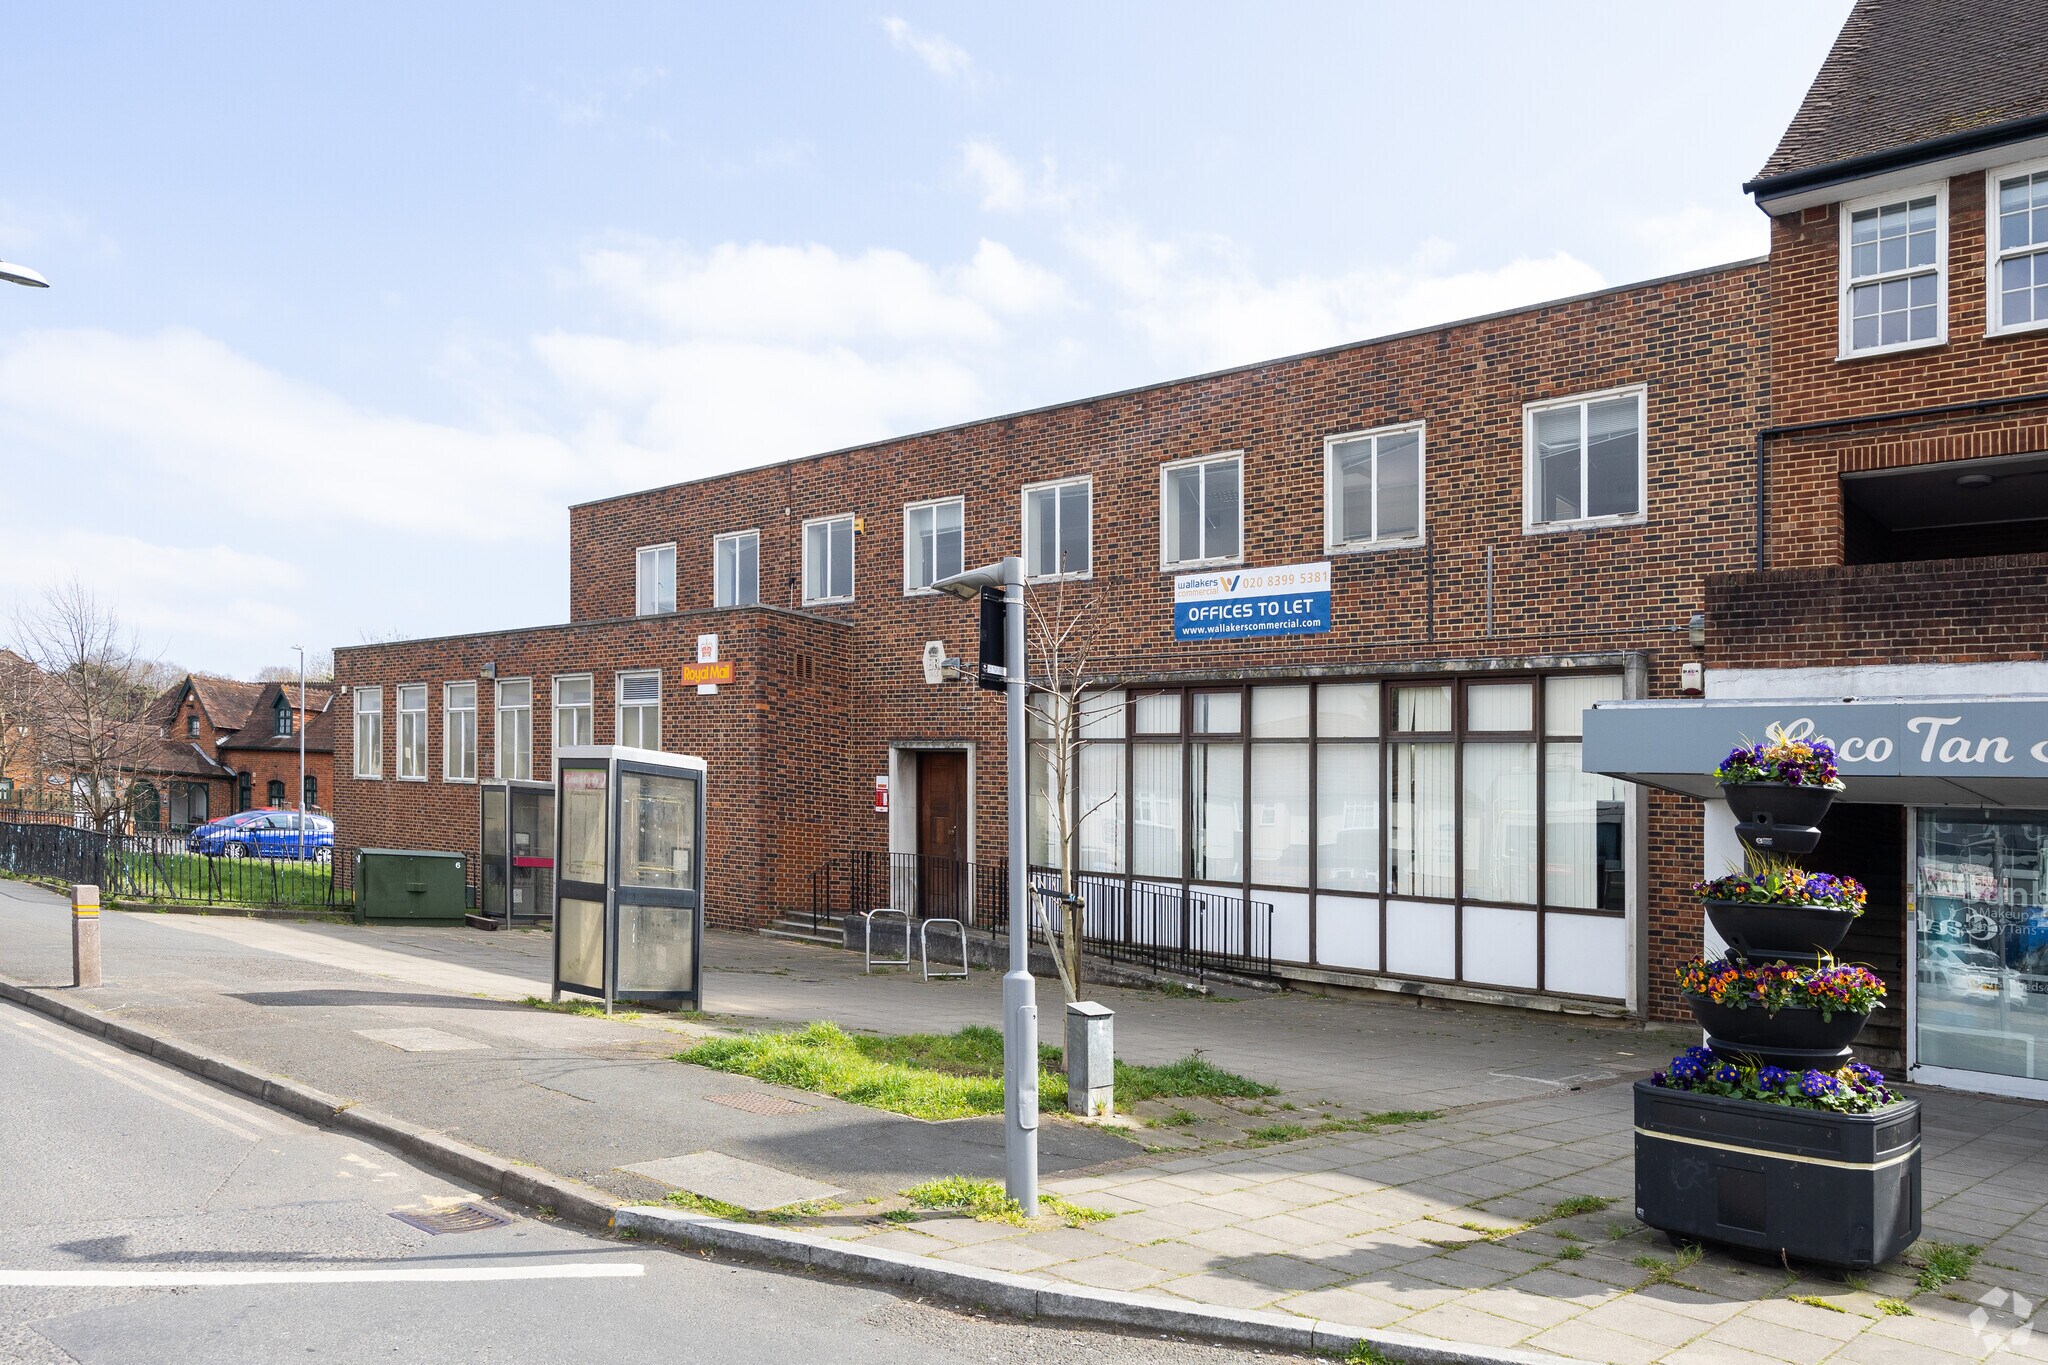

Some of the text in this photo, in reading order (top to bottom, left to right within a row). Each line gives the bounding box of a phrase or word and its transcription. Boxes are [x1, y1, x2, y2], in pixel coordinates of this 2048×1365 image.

[1178, 578, 1218, 589] wallakers
[1243, 571, 1328, 589] 020 8399 5381
[1178, 587, 1219, 598] commercial
[1188, 598, 1314, 622] OFFICES TO LET
[1182, 618, 1321, 635] www.wallakerscommercial.com
[683, 664, 729, 683] Royal Mail
[1907, 716, 2015, 763] Tan
[455, 861, 461, 869] 6
[1979, 907, 2029, 922] Makeup
[2008, 923, 2037, 935] Tans
